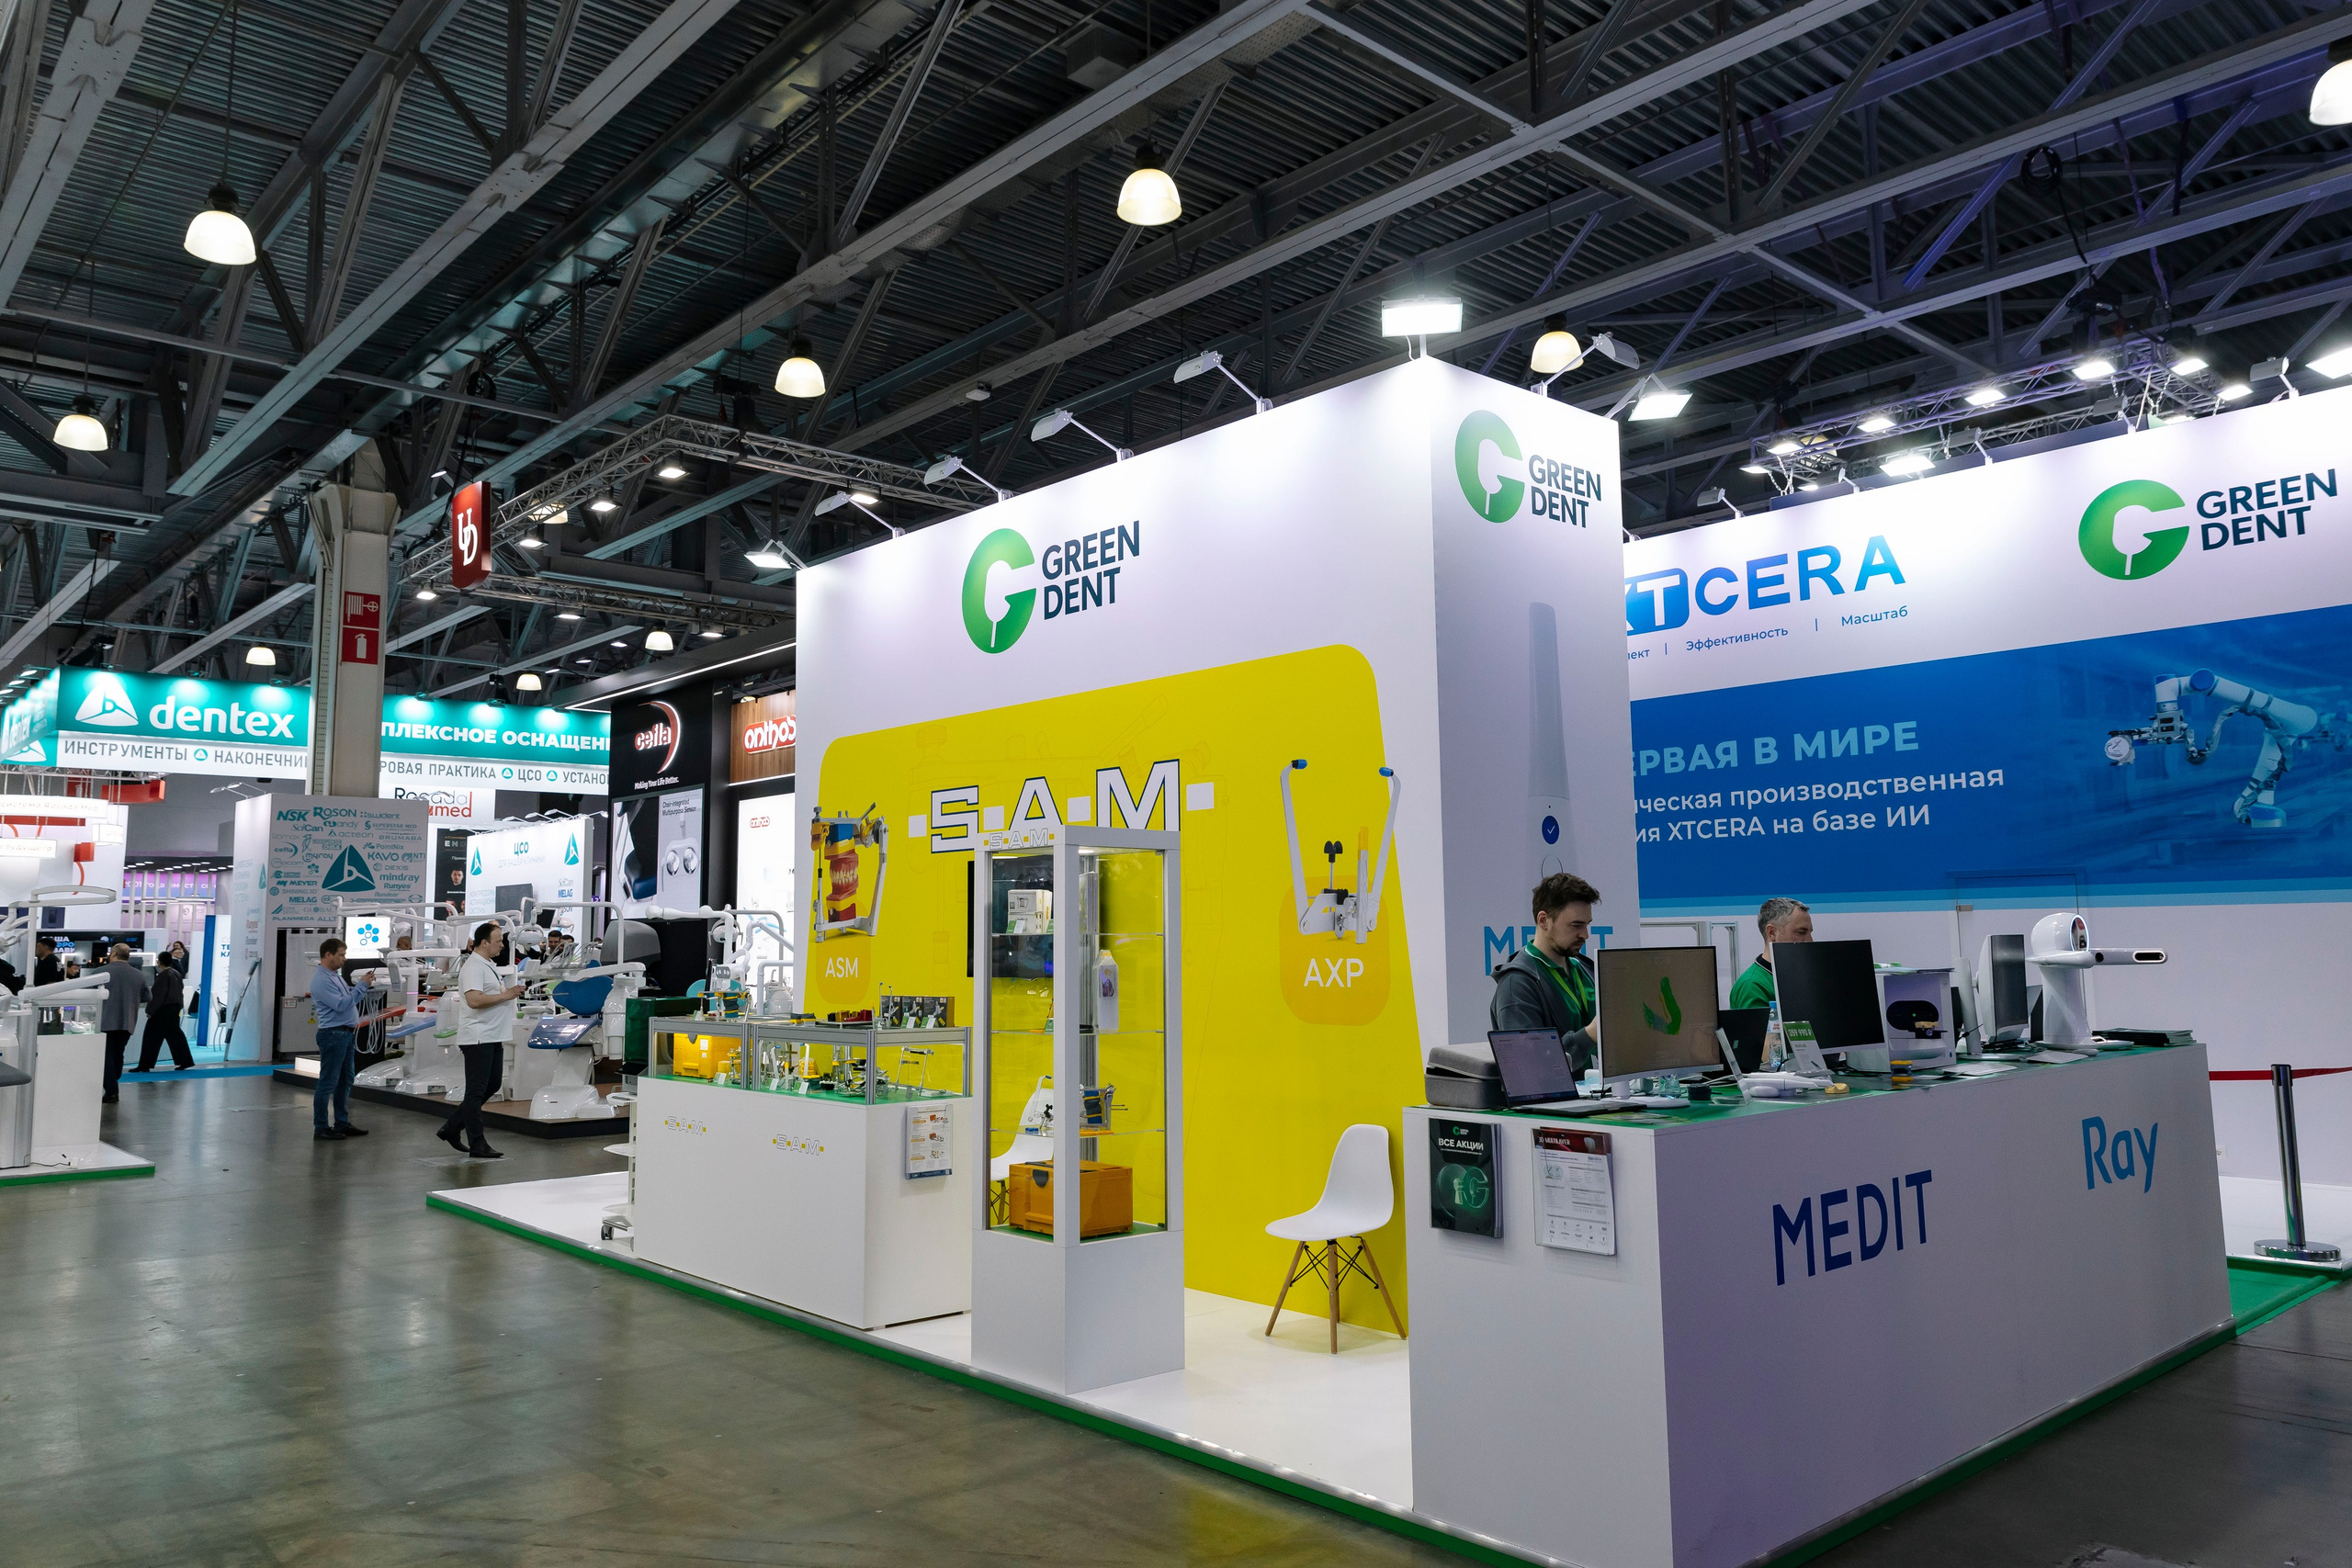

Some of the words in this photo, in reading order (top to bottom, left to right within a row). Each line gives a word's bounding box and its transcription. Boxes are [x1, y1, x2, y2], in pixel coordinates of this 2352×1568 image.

[1529, 455, 1602, 502] GREEN
[2196, 468, 2338, 519] GREEN
[1531, 485, 1589, 528] DENT
[2200, 505, 2312, 551] DENT
[1042, 520, 1140, 581] GREEN
[1044, 567, 1121, 621] DENT
[1686, 626, 1789, 651] Эффективность
[1841, 604, 1908, 627] Масштаб
[149, 695, 294, 739] dentex
[64, 740, 187, 761] ИНСТРУМЕНТЫ
[214, 750, 307, 768] НАКОНЕЧНИ
[635, 723, 672, 750] cefla
[1754, 737, 1779, 765] В
[1793, 720, 1919, 761] МИРЕ
[429, 763, 496, 779] ПРАКТИКА
[518, 769, 542, 783] ЦСО
[1730, 769, 2004, 809] производственная
[277, 809, 311, 821] NSK
[662, 798, 690, 808] Chair-integrated
[662, 808, 684, 817] Multipurpose
[684, 806, 697, 814] Sensor
[1668, 816, 1766, 841] XTCERA
[1773, 817, 1804, 834] на
[1812, 809, 1876, 831] базе
[1886, 804, 1930, 828] ИИ
[514, 841, 529, 857] ЦСО
[379, 873, 420, 883] mindray
[558, 888, 573, 897] MELAG
[825, 957, 858, 978] ASM
[1303, 957, 1364, 987] AXP
[1438, 1138, 1455, 1147] ВСЕ
[1456, 1140, 1484, 1151] АКЦИИ
[2081, 1115, 2159, 1194] Ray
[1772, 1168, 1932, 1286] MEDIT
